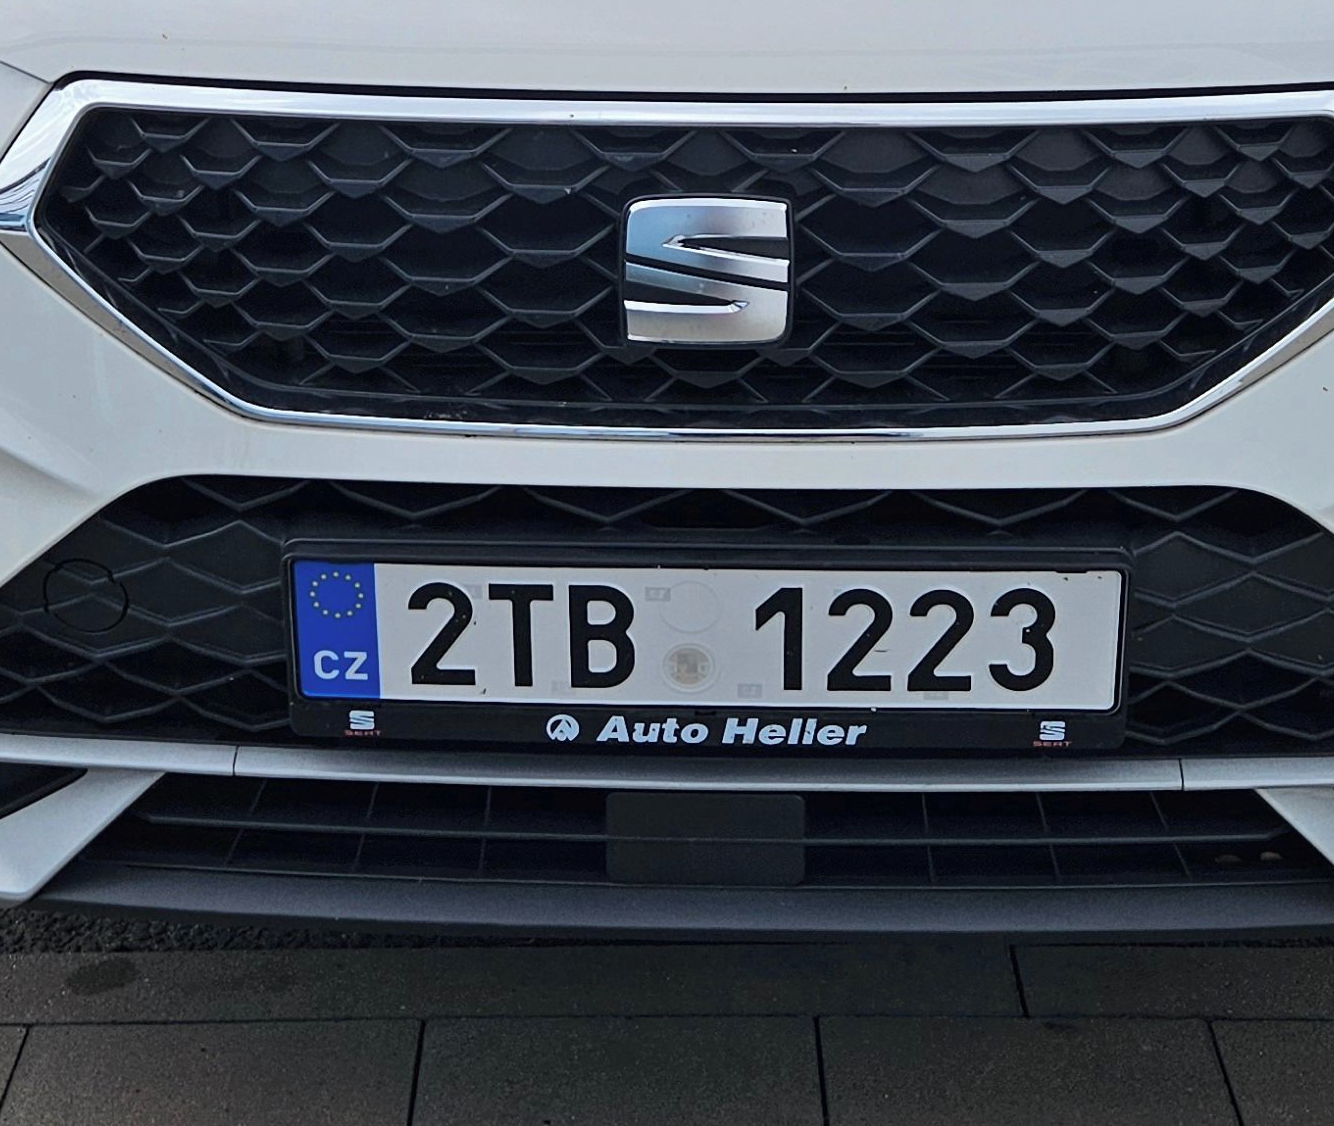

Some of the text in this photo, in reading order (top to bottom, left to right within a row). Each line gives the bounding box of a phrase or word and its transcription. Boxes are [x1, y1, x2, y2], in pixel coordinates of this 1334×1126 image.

[407, 581, 1056, 692] 2TB 1223
[313, 650, 368, 680] CZ
[596, 715, 868, 745] Auto Heller
